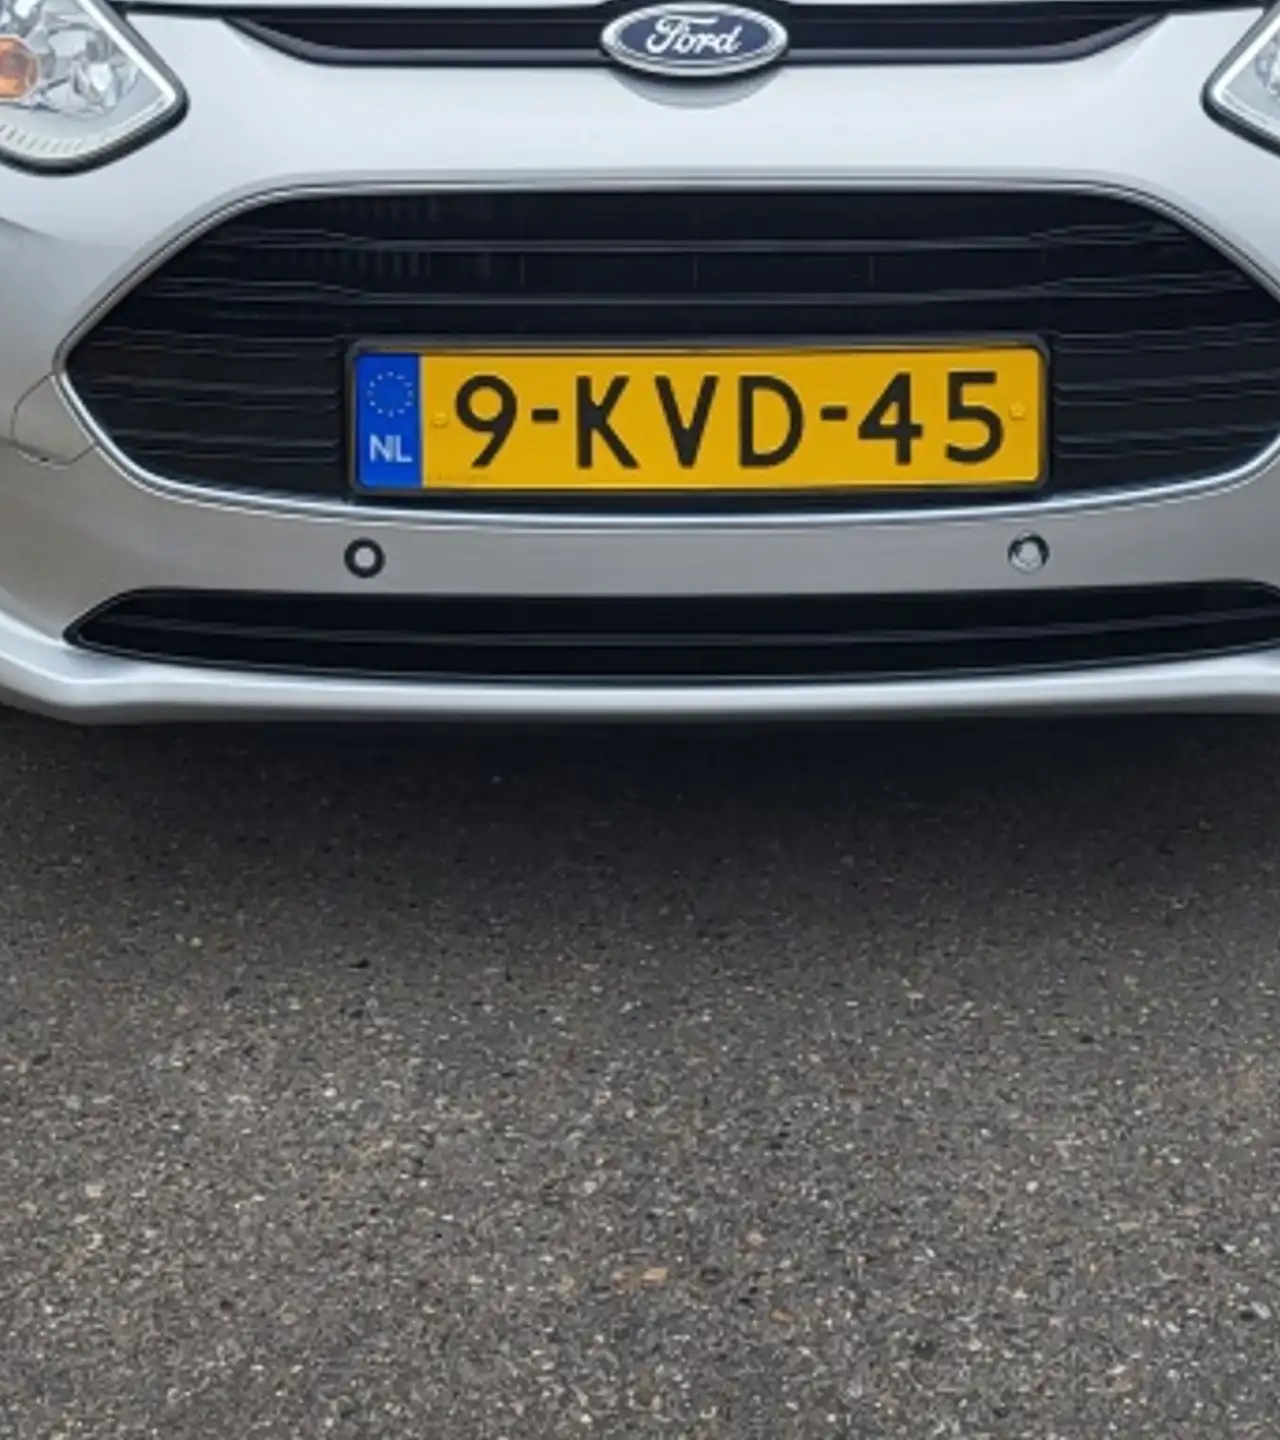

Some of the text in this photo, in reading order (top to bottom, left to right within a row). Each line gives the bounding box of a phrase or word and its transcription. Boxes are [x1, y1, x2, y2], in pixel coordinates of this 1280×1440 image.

[645, 15, 743, 54] Ford
[454, 370, 1006, 470] 9-KVD-45
[368, 435, 412, 464] NL
